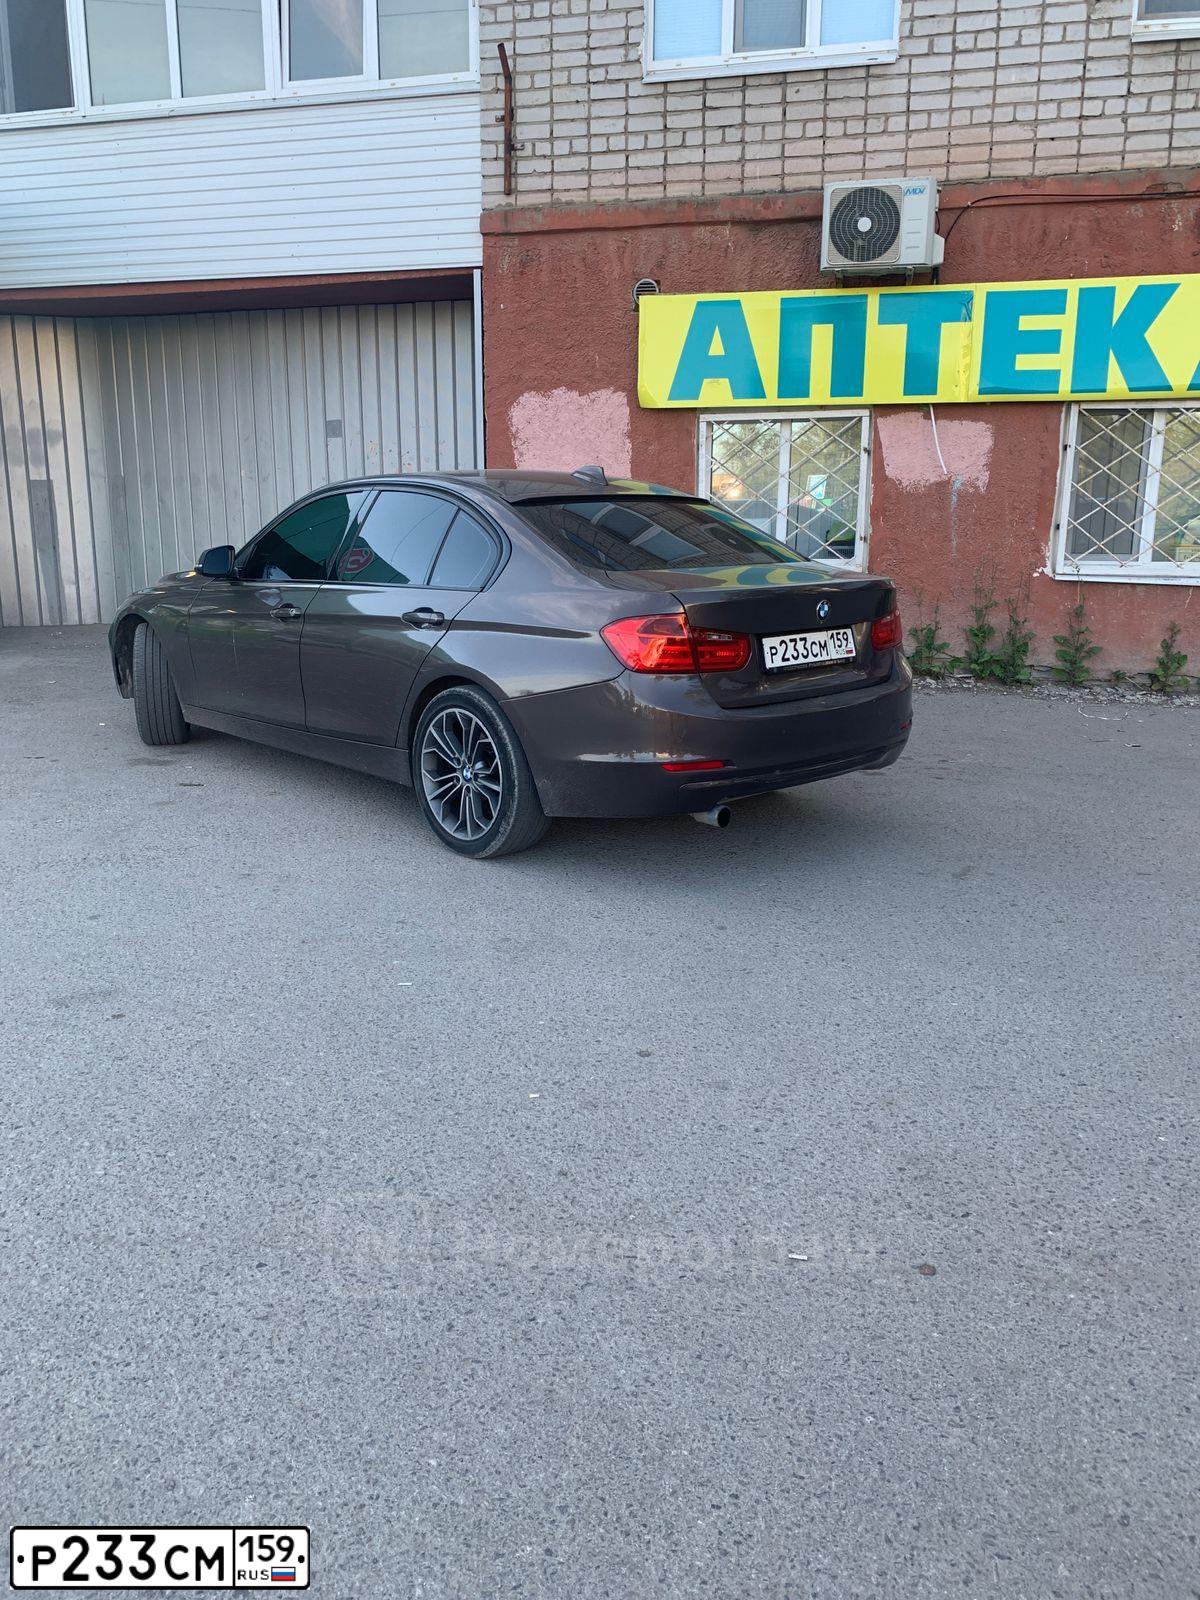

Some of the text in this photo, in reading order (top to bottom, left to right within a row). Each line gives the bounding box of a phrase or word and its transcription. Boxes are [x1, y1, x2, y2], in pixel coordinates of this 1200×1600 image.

[904, 187, 926, 196] MDV
[667, 282, 1200, 401] АПТЕК
[829, 631, 849, 649] 159
